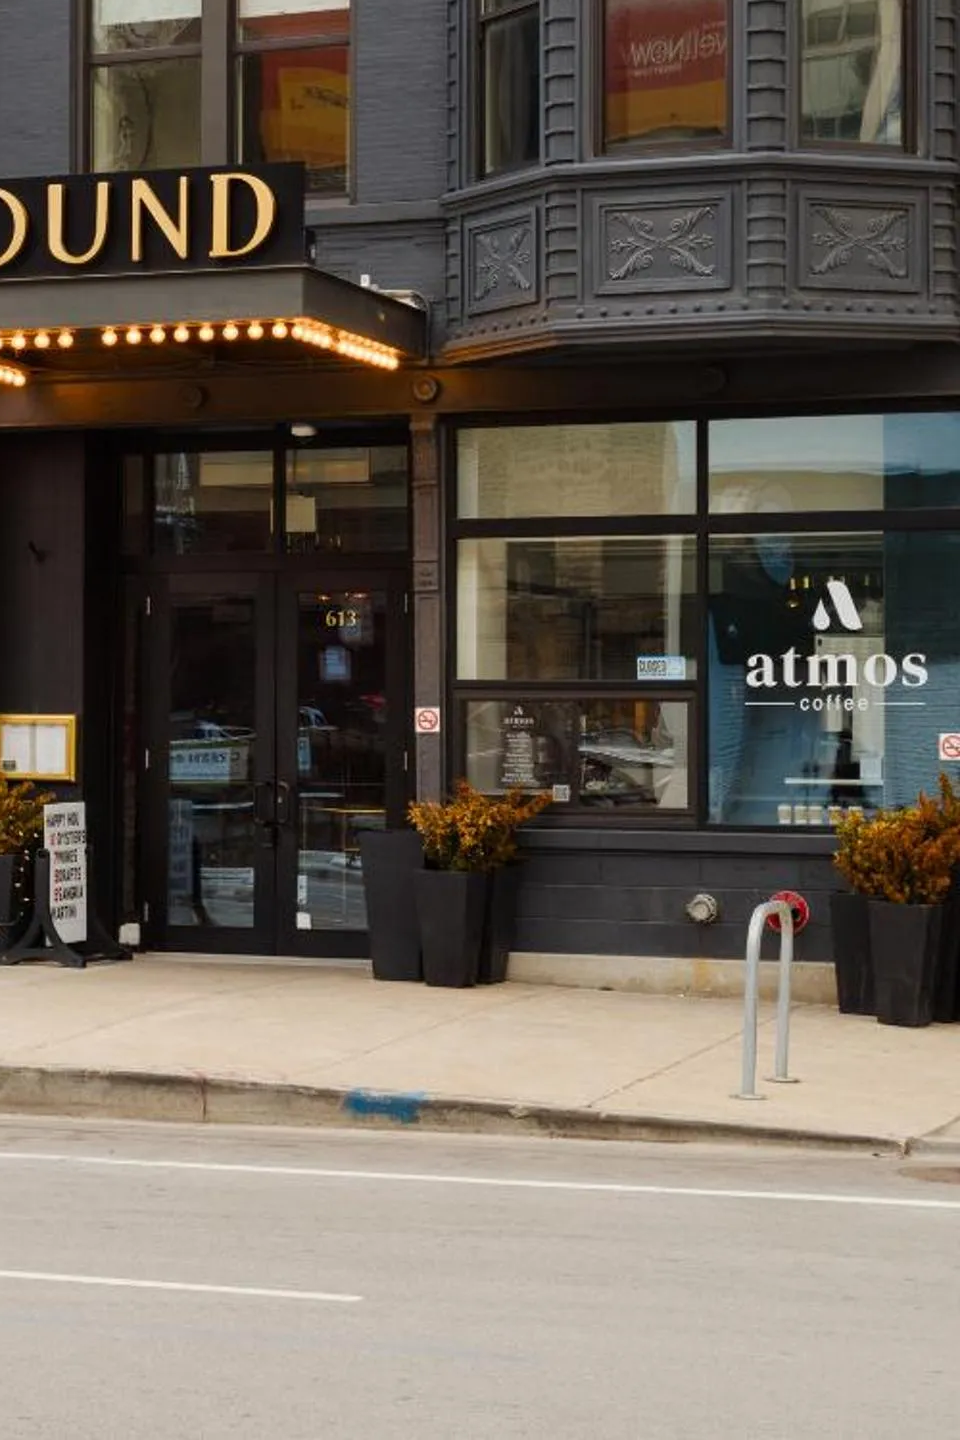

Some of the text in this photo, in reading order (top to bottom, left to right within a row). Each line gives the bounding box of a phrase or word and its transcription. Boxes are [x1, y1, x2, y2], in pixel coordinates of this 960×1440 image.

[325, 609, 357, 627] 613
[746, 646, 929, 688] atmos
[799, 694, 869, 711] coffee
